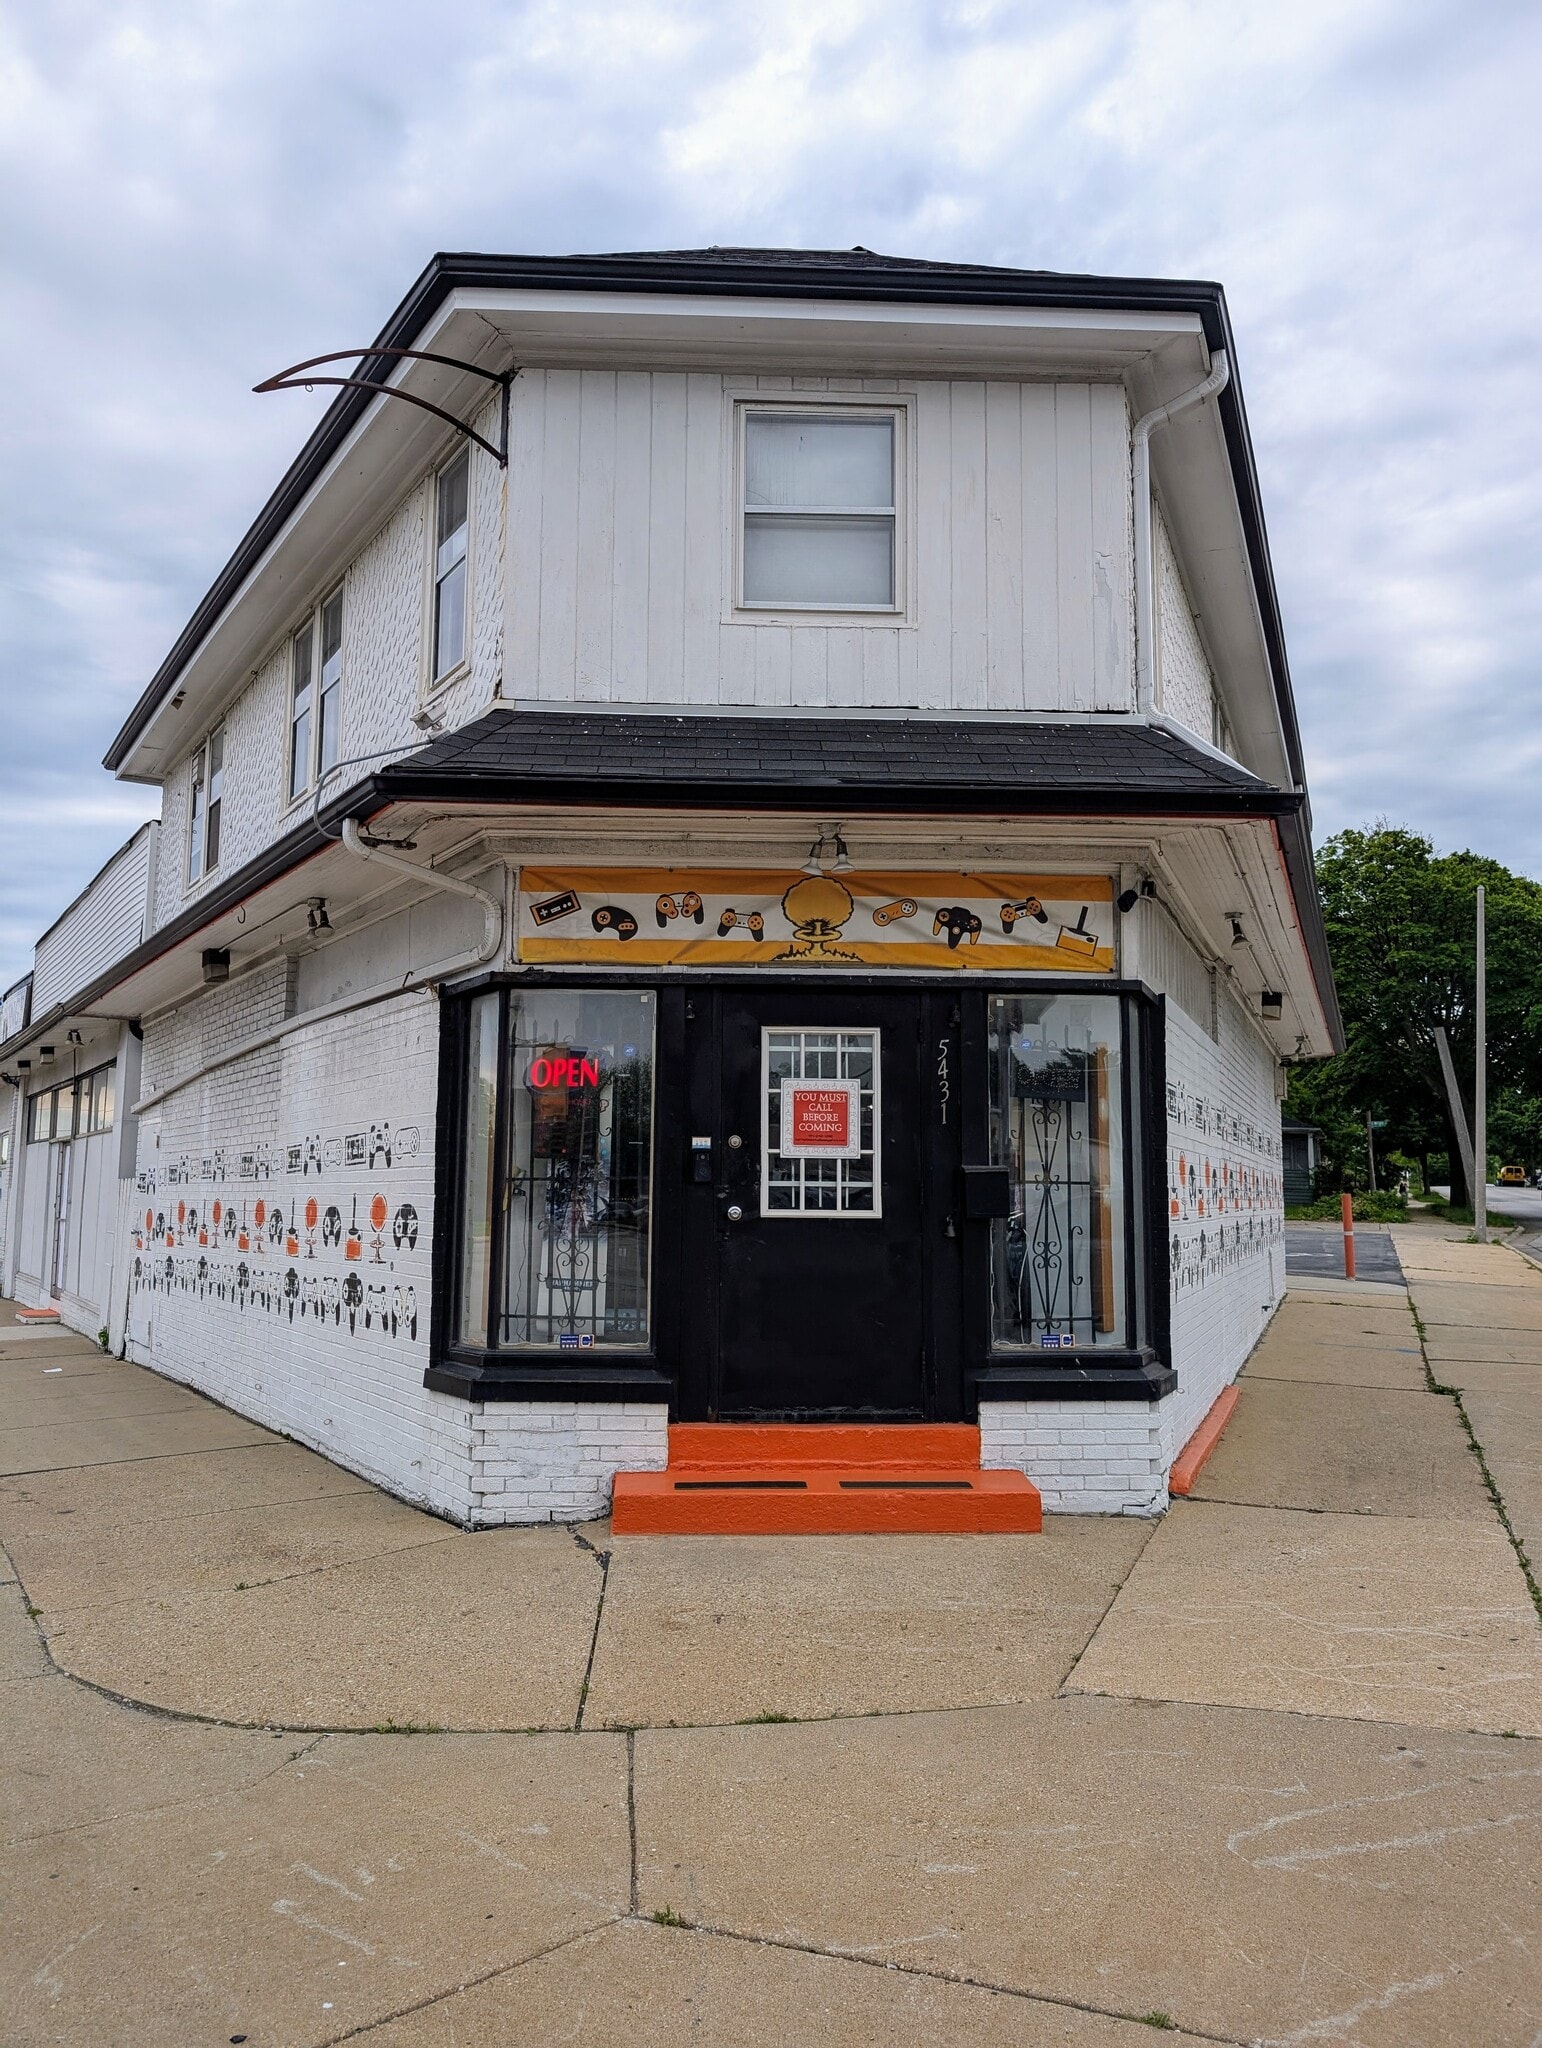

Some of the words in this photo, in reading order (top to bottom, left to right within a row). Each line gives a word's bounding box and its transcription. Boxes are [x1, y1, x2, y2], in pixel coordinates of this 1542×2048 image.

[530, 1058, 599, 1088] OPEN
[937, 1039, 950, 1125] 5431
[795, 1093, 817, 1102] YOU
[820, 1093, 848, 1102] MUST
[808, 1103, 833, 1112] CALL
[802, 1113, 839, 1122] BEFORE
[798, 1123, 843, 1132] COMING
